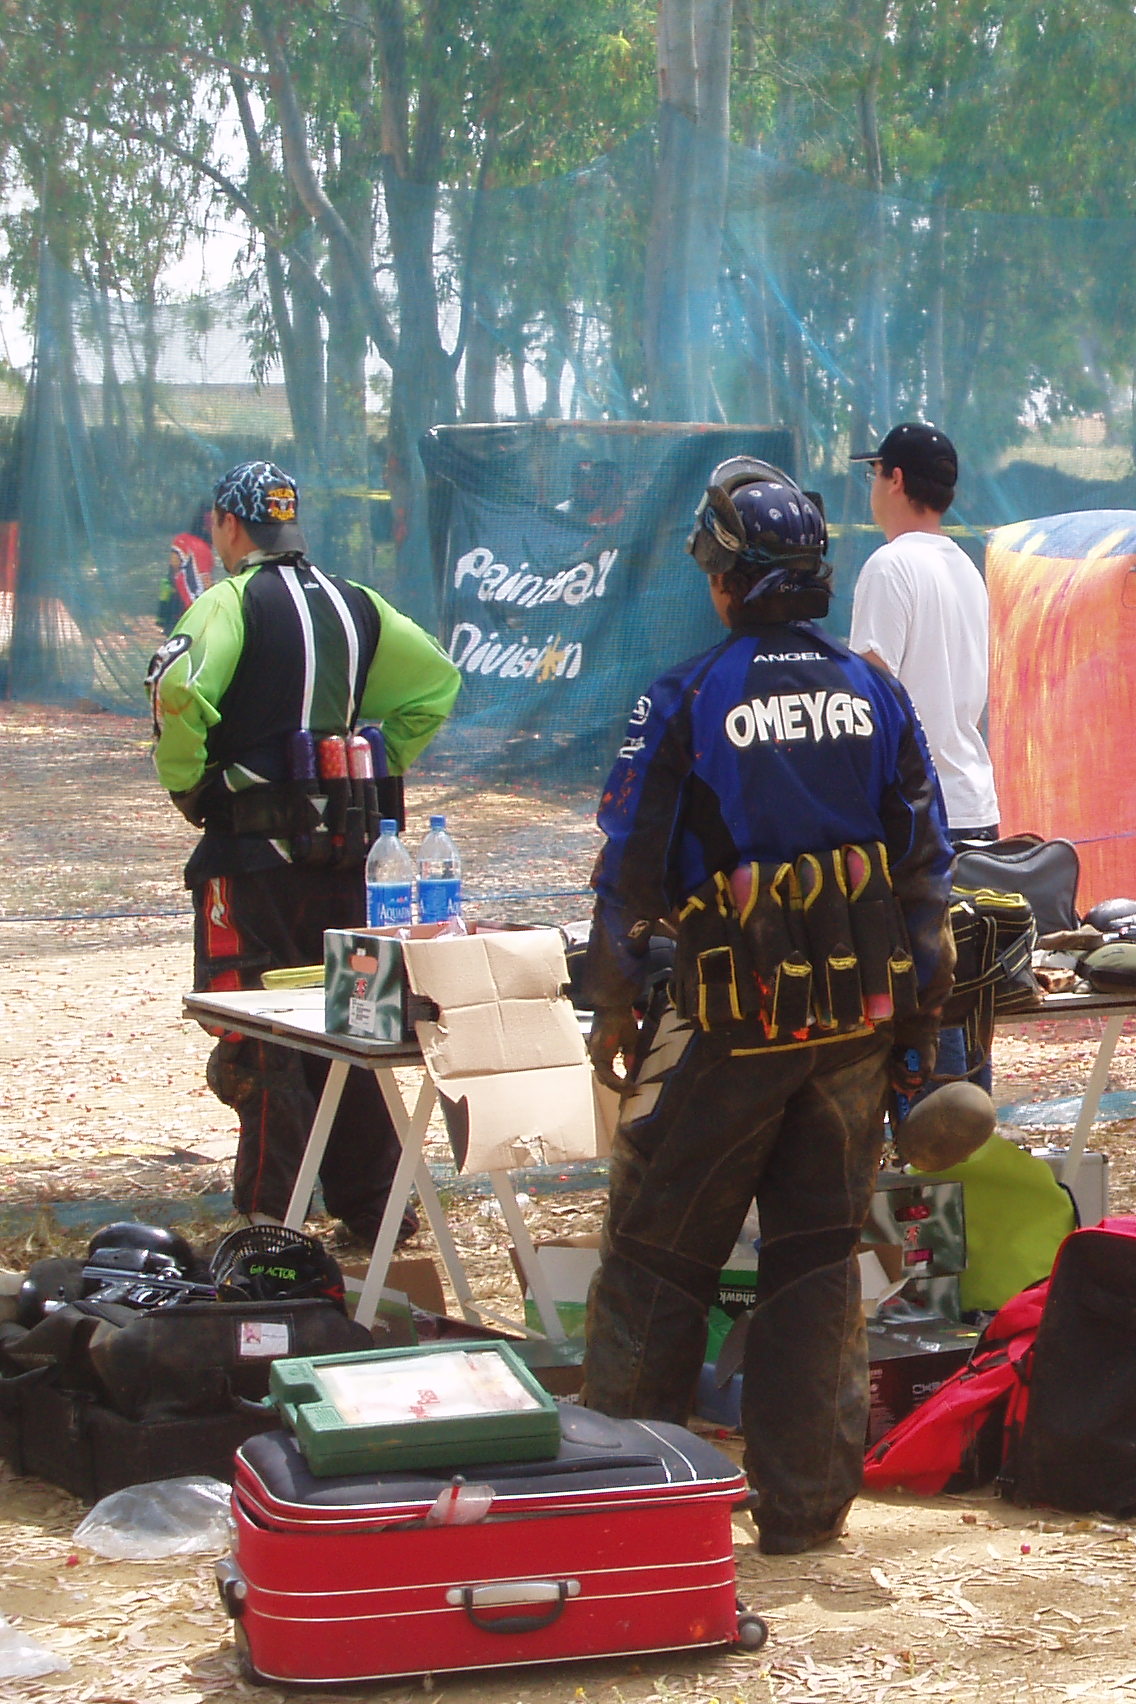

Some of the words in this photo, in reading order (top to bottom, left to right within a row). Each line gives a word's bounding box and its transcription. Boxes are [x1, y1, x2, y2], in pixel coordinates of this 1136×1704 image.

[753, 652, 828, 663] ANGEL
[725, 690, 874, 747] OMEYAS
[719, 1291, 757, 1306] ahawk
